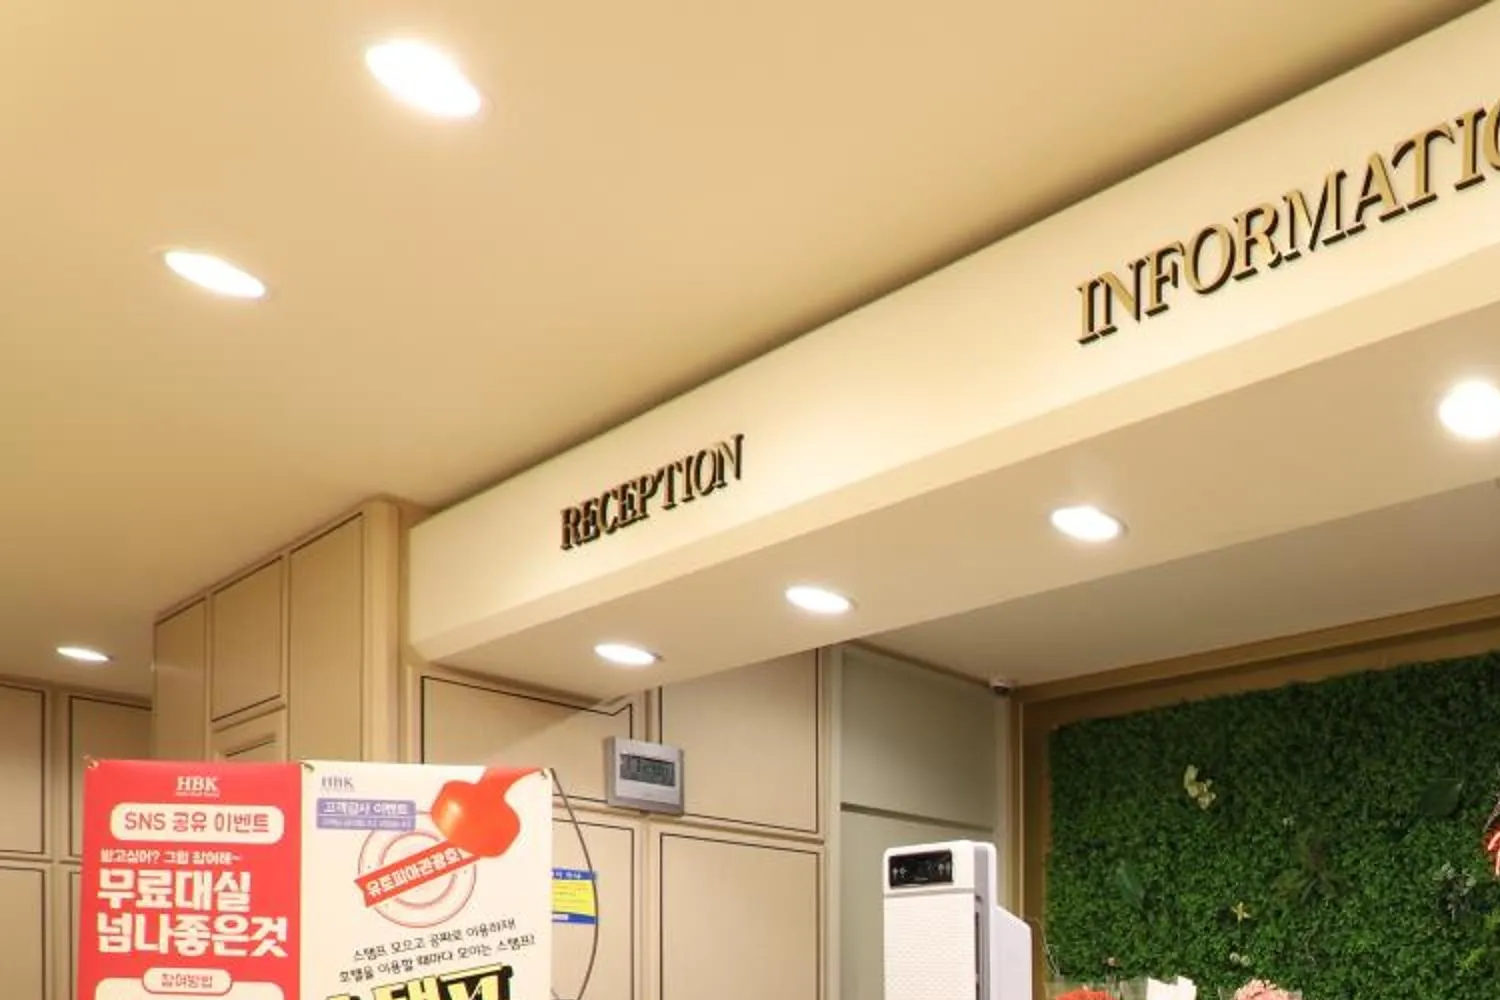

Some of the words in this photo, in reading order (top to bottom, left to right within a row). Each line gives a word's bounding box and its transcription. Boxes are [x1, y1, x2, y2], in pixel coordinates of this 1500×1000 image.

[560, 434, 745, 550] RECEPTION
[176, 776, 219, 791] HBK
[124, 812, 166, 831] SNS
[172, 812, 208, 833] 공유
[214, 813, 270, 834] 이벤트
[97, 868, 251, 913] 무료대실
[366, 846, 466, 898] 유토피아관광호
[97, 912, 289, 958] 넘나좋은것
